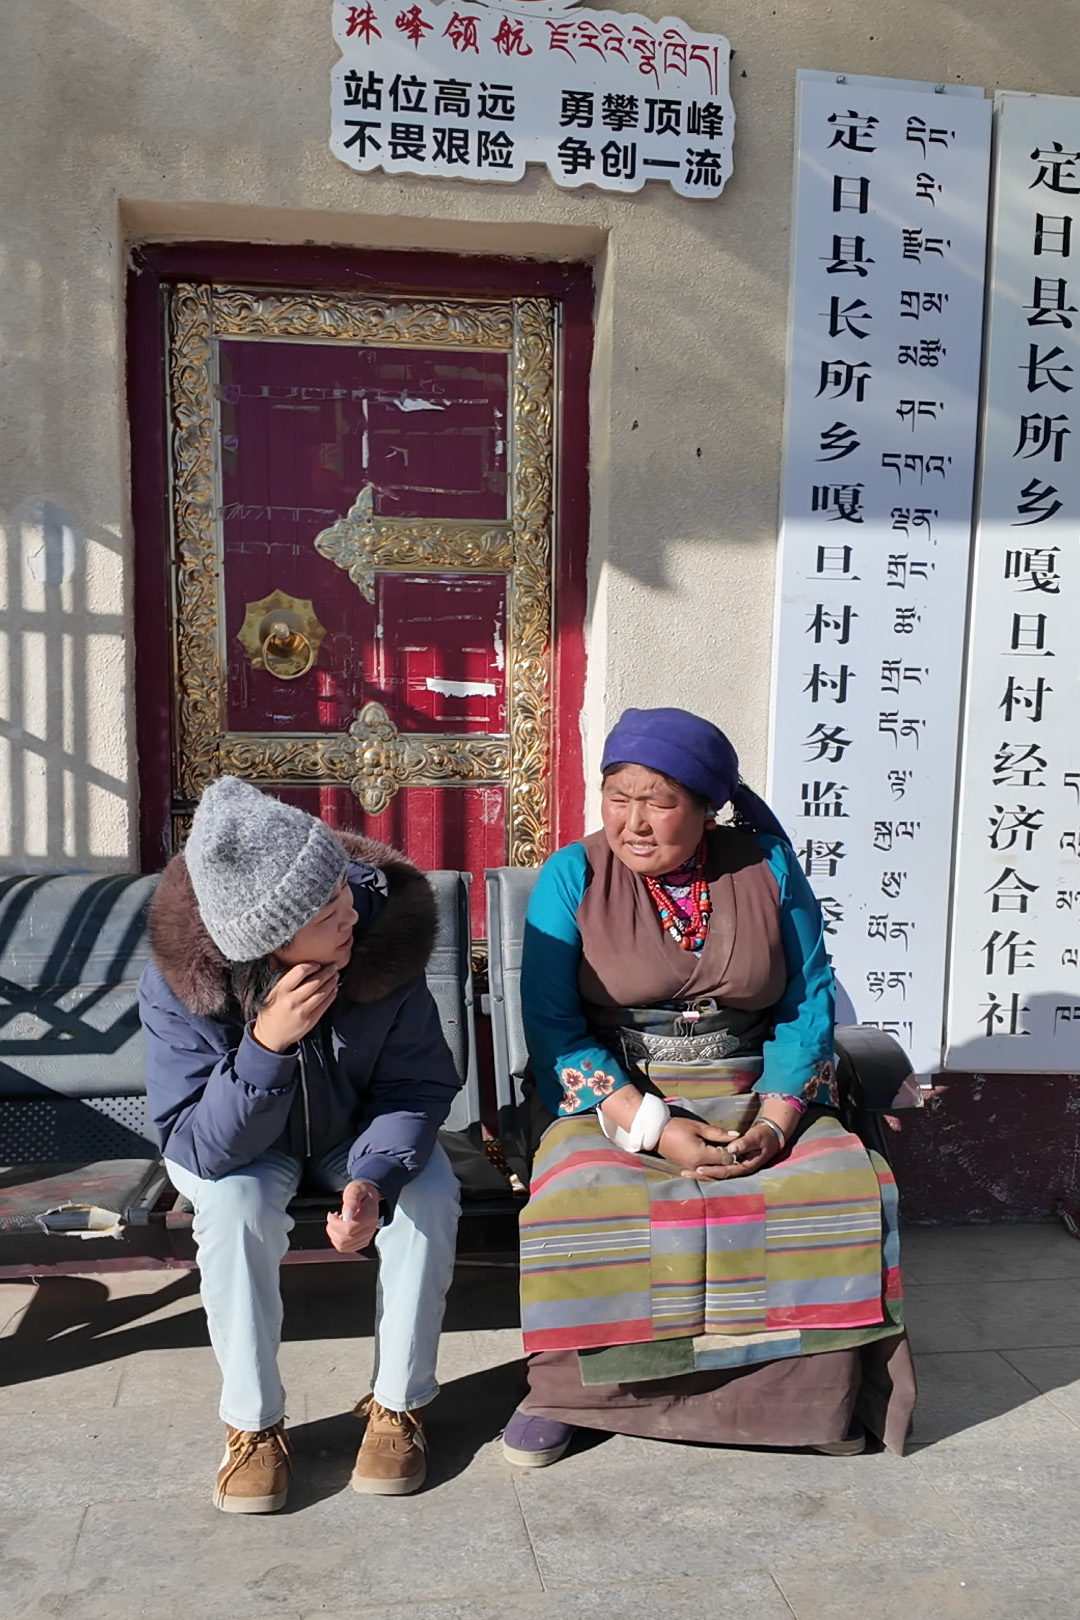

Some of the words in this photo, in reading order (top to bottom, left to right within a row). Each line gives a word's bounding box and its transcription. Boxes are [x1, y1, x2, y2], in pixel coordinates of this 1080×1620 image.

[345, 1, 534, 57] 珠峰领航
[343, 69, 516, 123] 站位高远
[558, 88, 724, 141] 勇攀顶峰
[343, 119, 515, 170] 不畏艰险
[557, 136, 723, 188] 争创一流
[795, 109, 880, 1028] 定日县长所乡嘎旦村村务监督
[977, 141, 1080, 1037] 定日县长所乡嘎旦村经济合作社
